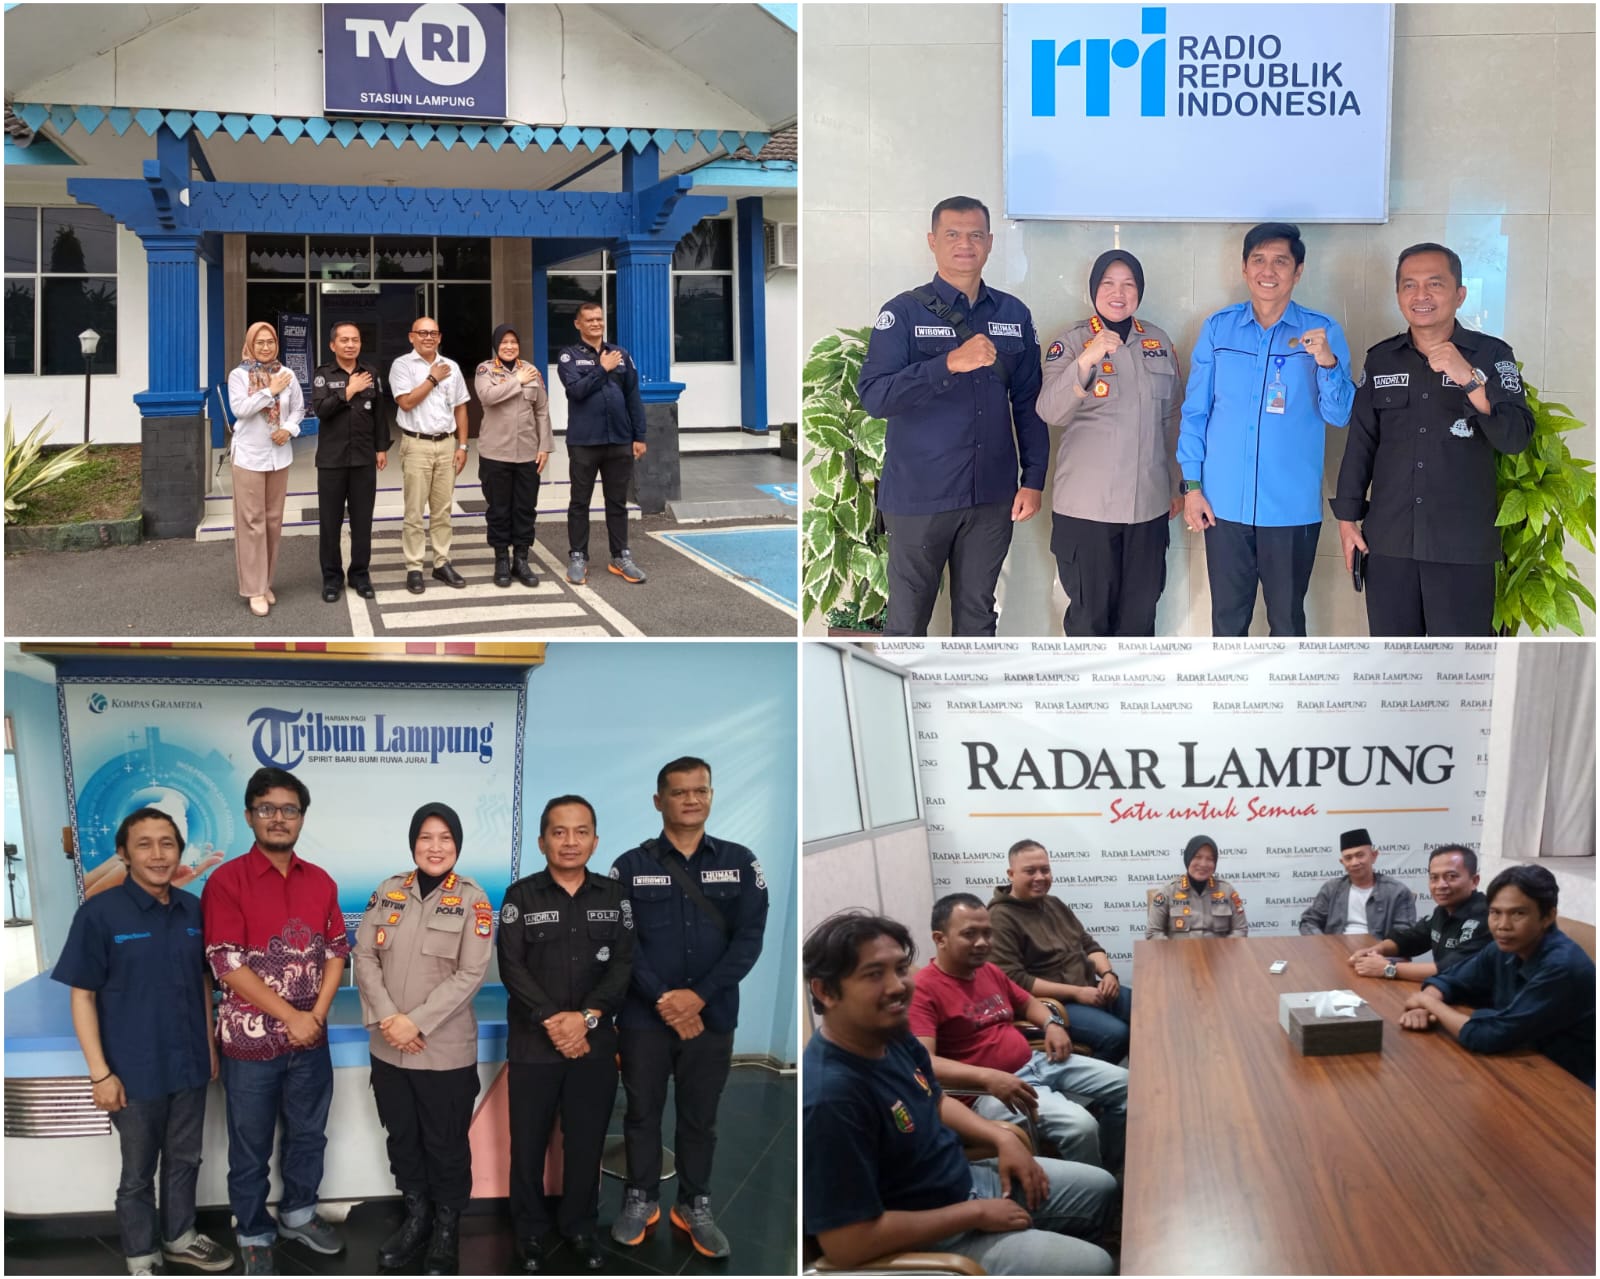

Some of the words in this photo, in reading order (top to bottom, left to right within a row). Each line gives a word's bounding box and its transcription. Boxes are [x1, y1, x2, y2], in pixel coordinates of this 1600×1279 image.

[345, 18, 470, 63] TVRI
[1178, 34, 1282, 60] RADIO
[1032, 7, 1166, 117] rri
[1178, 62, 1343, 89] REPUBLIK
[360, 92, 412, 105] STASIUN
[415, 95, 475, 107] LAMPUNG
[1178, 91, 1361, 117] INDONESIA
[918, 328, 951, 336] WIBOWO
[1143, 349, 1168, 358] POLRI
[941, 641, 971, 650] RADAR
[975, 641, 1019, 650] LAMPUNG
[1032, 642, 1061, 651] RADAR
[1064, 642, 1107, 651] LAMPUNG
[1118, 642, 1148, 651] RADAR
[1150, 642, 1192, 651] LAMPUNG
[1213, 642, 1241, 650] RADAR
[1244, 642, 1285, 650] LAMPUNG
[1299, 642, 1326, 650] RADAR
[1329, 642, 1369, 650] LAMPUNG
[1384, 642, 1411, 650] RADAR
[1414, 642, 1453, 650] LAMPUNG
[912, 672, 942, 681] RADAR
[945, 672, 988, 681] LAMPUNG
[1004, 673, 1034, 681] RADAR
[1036, 673, 1079, 681] LAMPUNG
[1092, 673, 1120, 681] RADAR
[1123, 673, 1165, 681] LAMPUNG
[1177, 673, 1205, 681] RADAR
[1207, 673, 1248, 681] LAMPUNG
[1269, 673, 1297, 681] RADAR
[1299, 673, 1339, 681] LAMPUNG
[1353, 672, 1380, 681] RADAR
[1383, 672, 1422, 680] LAMPUNG
[1437, 672, 1463, 681] RADAR
[111, 699, 149, 708] KOMPAS
[152, 699, 202, 709] GRAMEDIA
[947, 701, 977, 709] RADAR
[980, 701, 1024, 709] LAMPUNG
[1035, 701, 1064, 710] RADAR
[1067, 701, 1109, 710] LAMPUNG
[1120, 701, 1149, 710] RADAR
[1151, 701, 1192, 710] LAMPUNG
[1213, 701, 1240, 710] RADAR
[1243, 701, 1283, 709] LAMPUNG
[1297, 701, 1325, 709] RADAR
[1327, 700, 1367, 708] LAMPUNG
[1381, 700, 1408, 708] RADAR
[1410, 699, 1449, 708] LAMPUNG
[247, 707, 366, 771] Tribun
[374, 714, 494, 764] Lampung
[405, 756, 427, 764] JURAI
[961, 741, 1165, 790] RADAR
[1178, 741, 1456, 789] LAMPUNG
[1110, 798, 1162, 824] Satu
[1166, 796, 1239, 821] untuk
[1246, 796, 1319, 822] Semua
[1101, 849, 1128, 857] RADAR
[1131, 849, 1170, 857] LAMPUNG
[1266, 847, 1292, 855] RADAR
[1294, 846, 1332, 854] LAMPUNG
[932, 851, 960, 860] RADAR
[963, 851, 1005, 860] LAMPUNG
[1128, 874, 1152, 882] RADAR
[1242, 871, 1279, 879] LAMPUNG
[1293, 870, 1317, 878] RADAR
[966, 876, 993, 885] RADAR
[1104, 901, 1130, 909] RADAR
[1265, 897, 1290, 905] RADAR
[435, 906, 464, 916] POLRI
[1087, 924, 1119, 932] AMPUNG
[1248, 920, 1279, 928] AMPUNG
